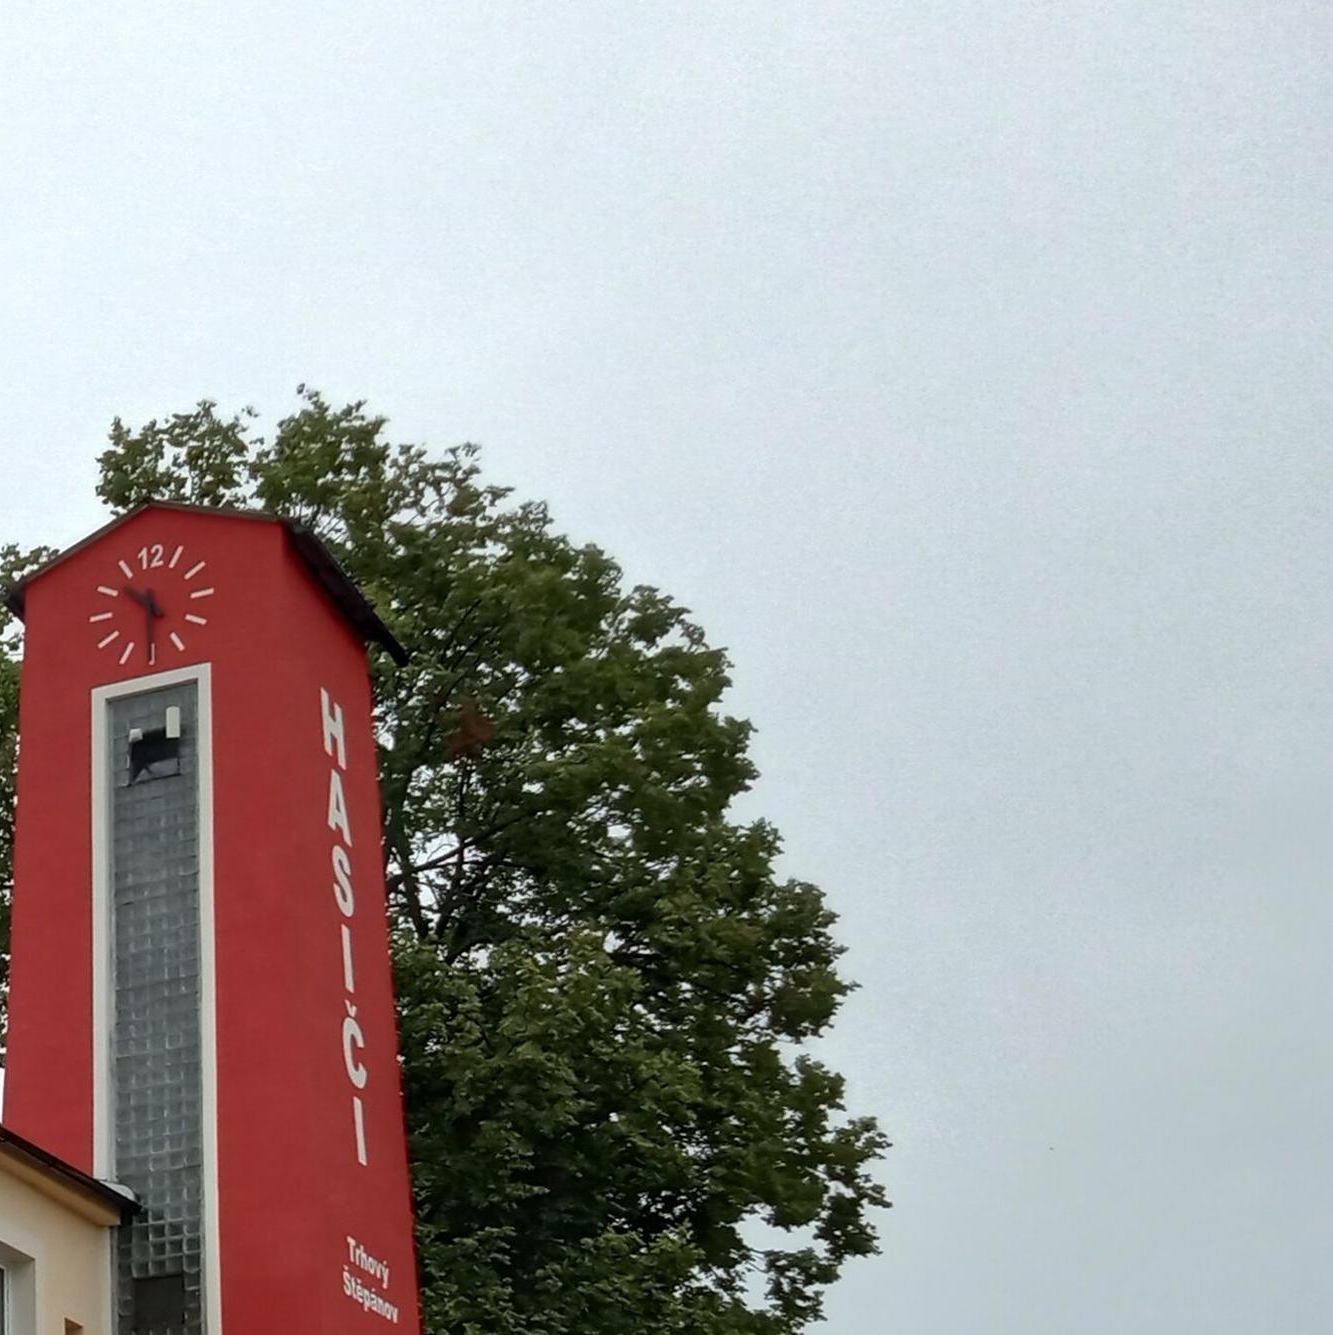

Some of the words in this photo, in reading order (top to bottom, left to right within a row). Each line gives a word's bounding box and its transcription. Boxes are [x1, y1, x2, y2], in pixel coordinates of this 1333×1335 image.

[138, 544, 164, 570] 12
[321, 687, 367, 1166] HASIČI
[346, 1235, 389, 1289] Trhový
[343, 1264, 398, 1324] Štěpánov
